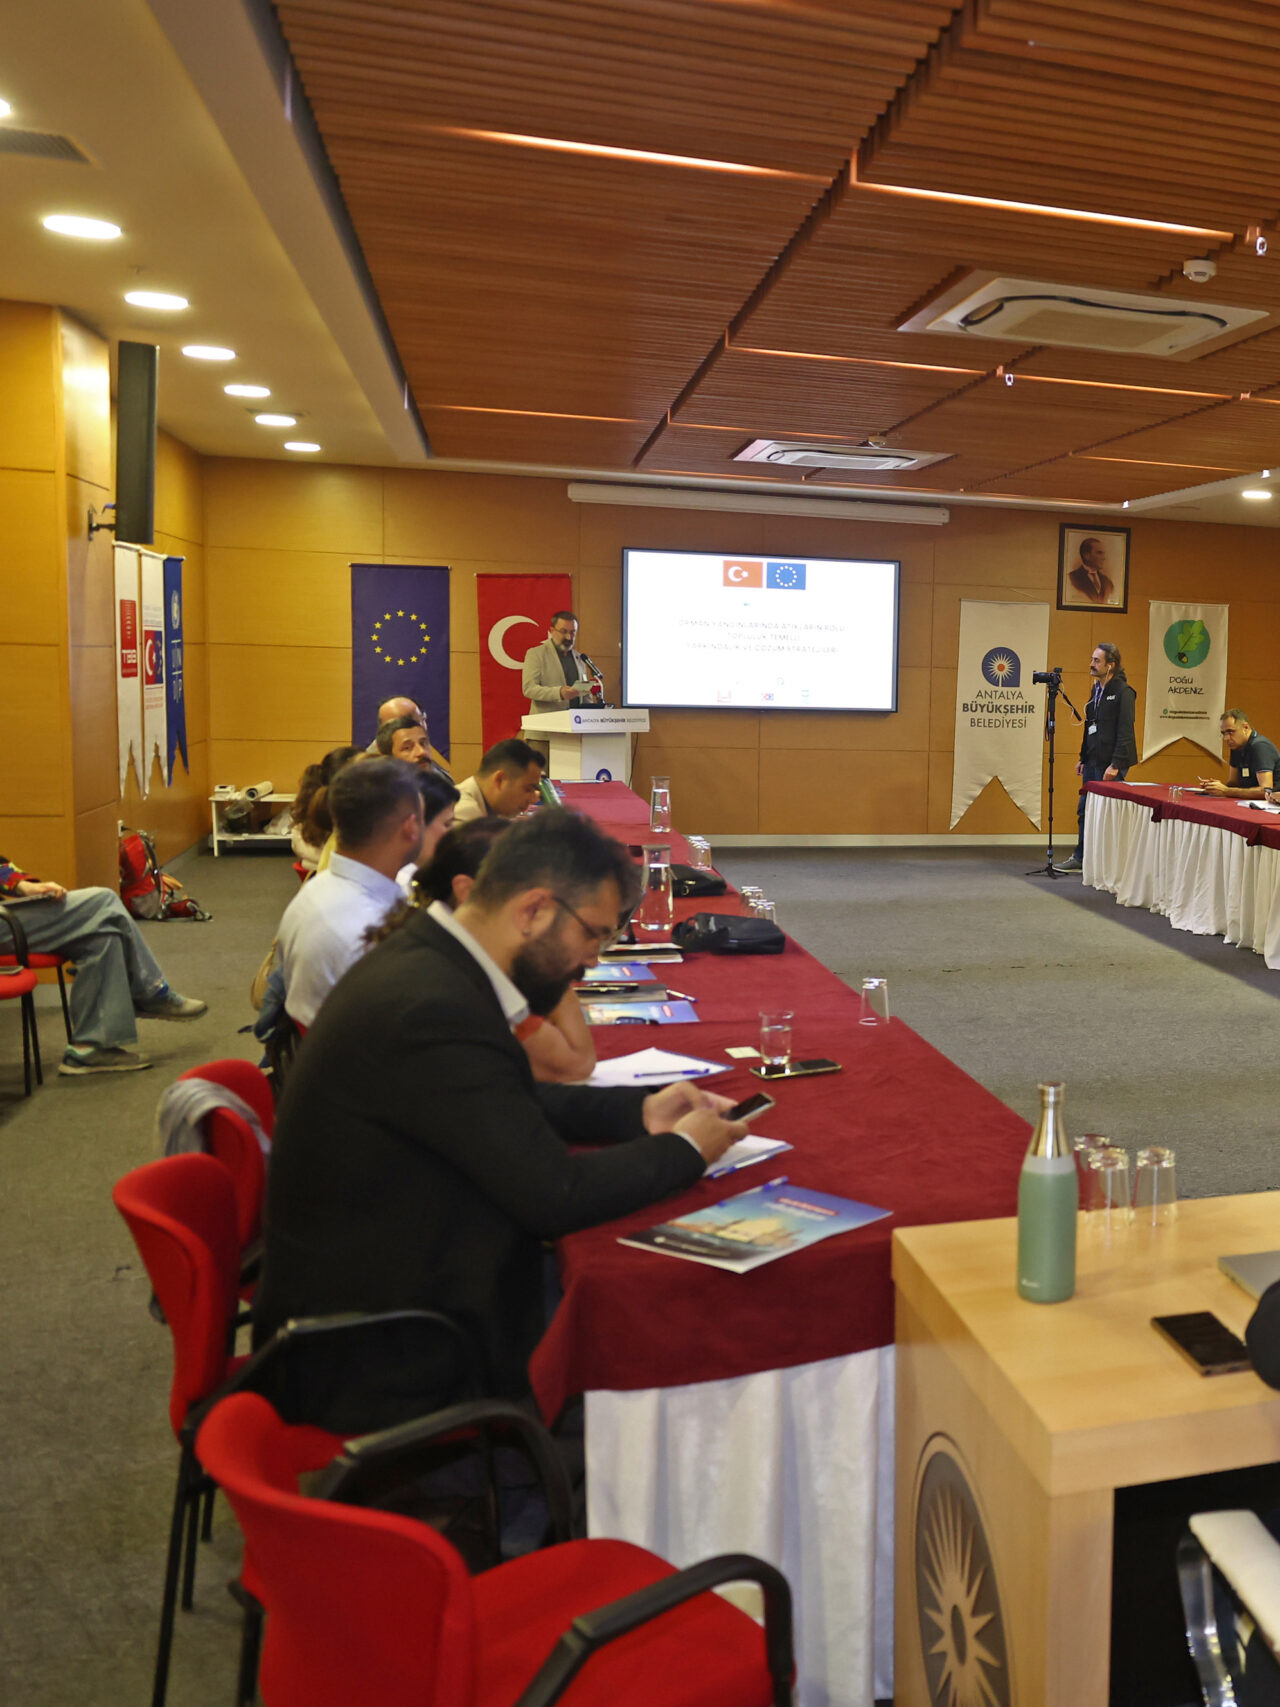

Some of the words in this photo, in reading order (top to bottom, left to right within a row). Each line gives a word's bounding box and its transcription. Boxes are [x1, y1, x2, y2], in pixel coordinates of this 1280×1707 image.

[1169, 676, 1193, 684] DOĞU
[975, 690, 1024, 700] ANTALYA
[962, 701, 1035, 716] BÜYÜKŞEHİR
[970, 716, 1027, 729] BELEDİYESİ
